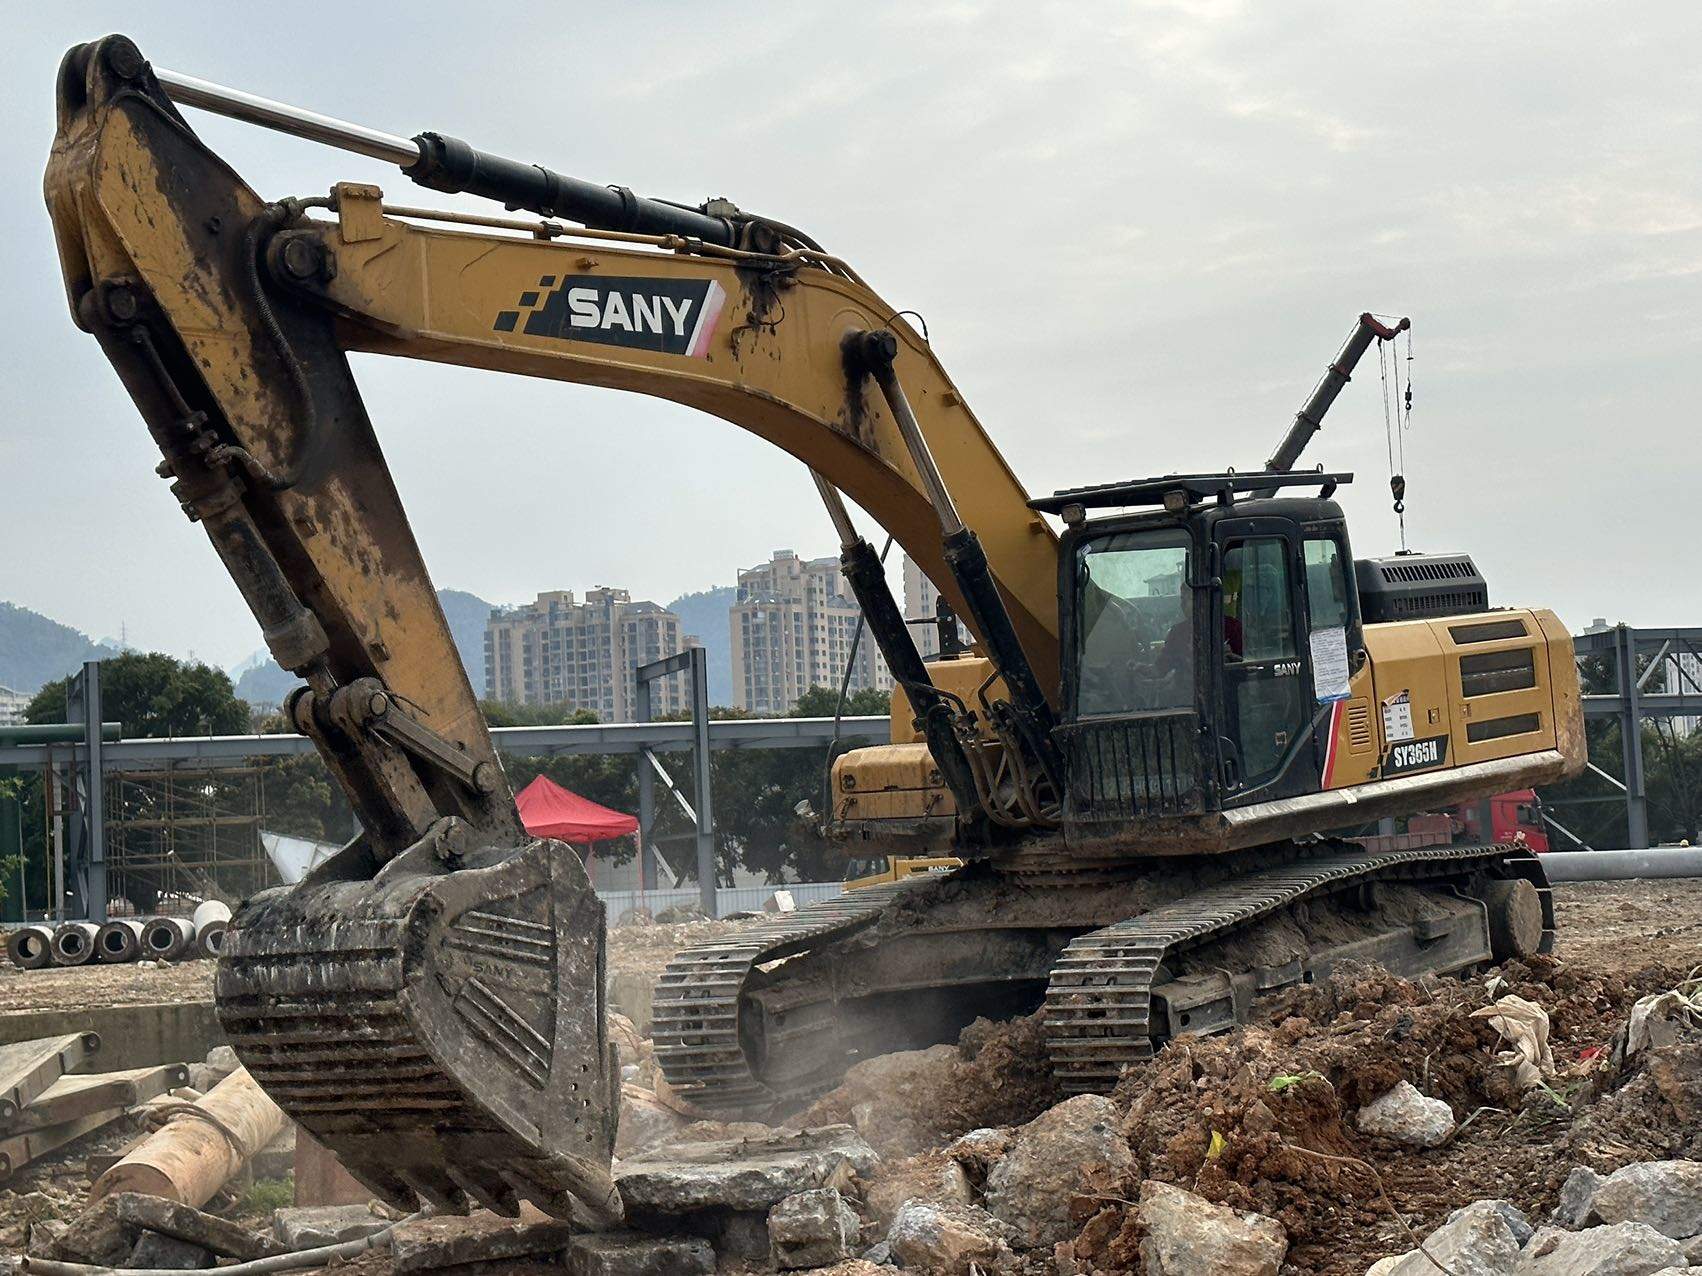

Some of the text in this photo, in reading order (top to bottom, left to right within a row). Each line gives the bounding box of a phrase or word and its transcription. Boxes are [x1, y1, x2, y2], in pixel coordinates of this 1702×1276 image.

[568, 287, 692, 336] SANY
[1273, 661, 1301, 677] SANY
[1393, 740, 1438, 768] SY365H
